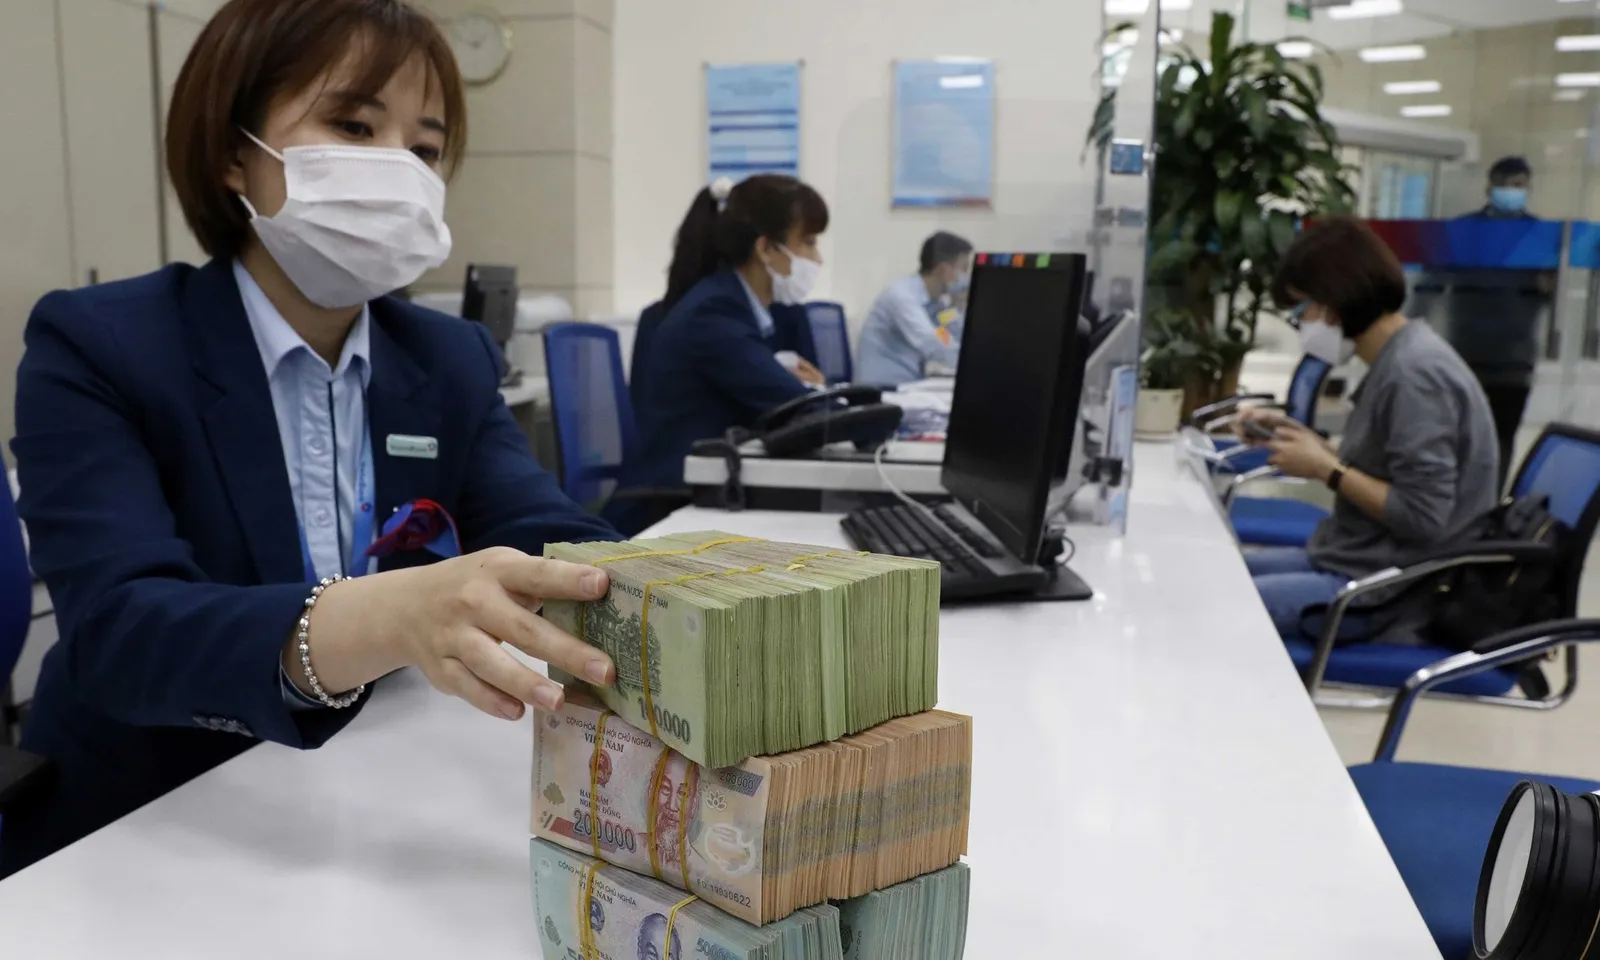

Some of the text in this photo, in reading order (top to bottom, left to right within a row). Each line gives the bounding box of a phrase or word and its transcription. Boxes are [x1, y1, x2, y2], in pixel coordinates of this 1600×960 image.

[605, 739, 625, 753] NAM
[596, 890, 613, 904] NAM
[709, 885, 752, 908] 19930622
